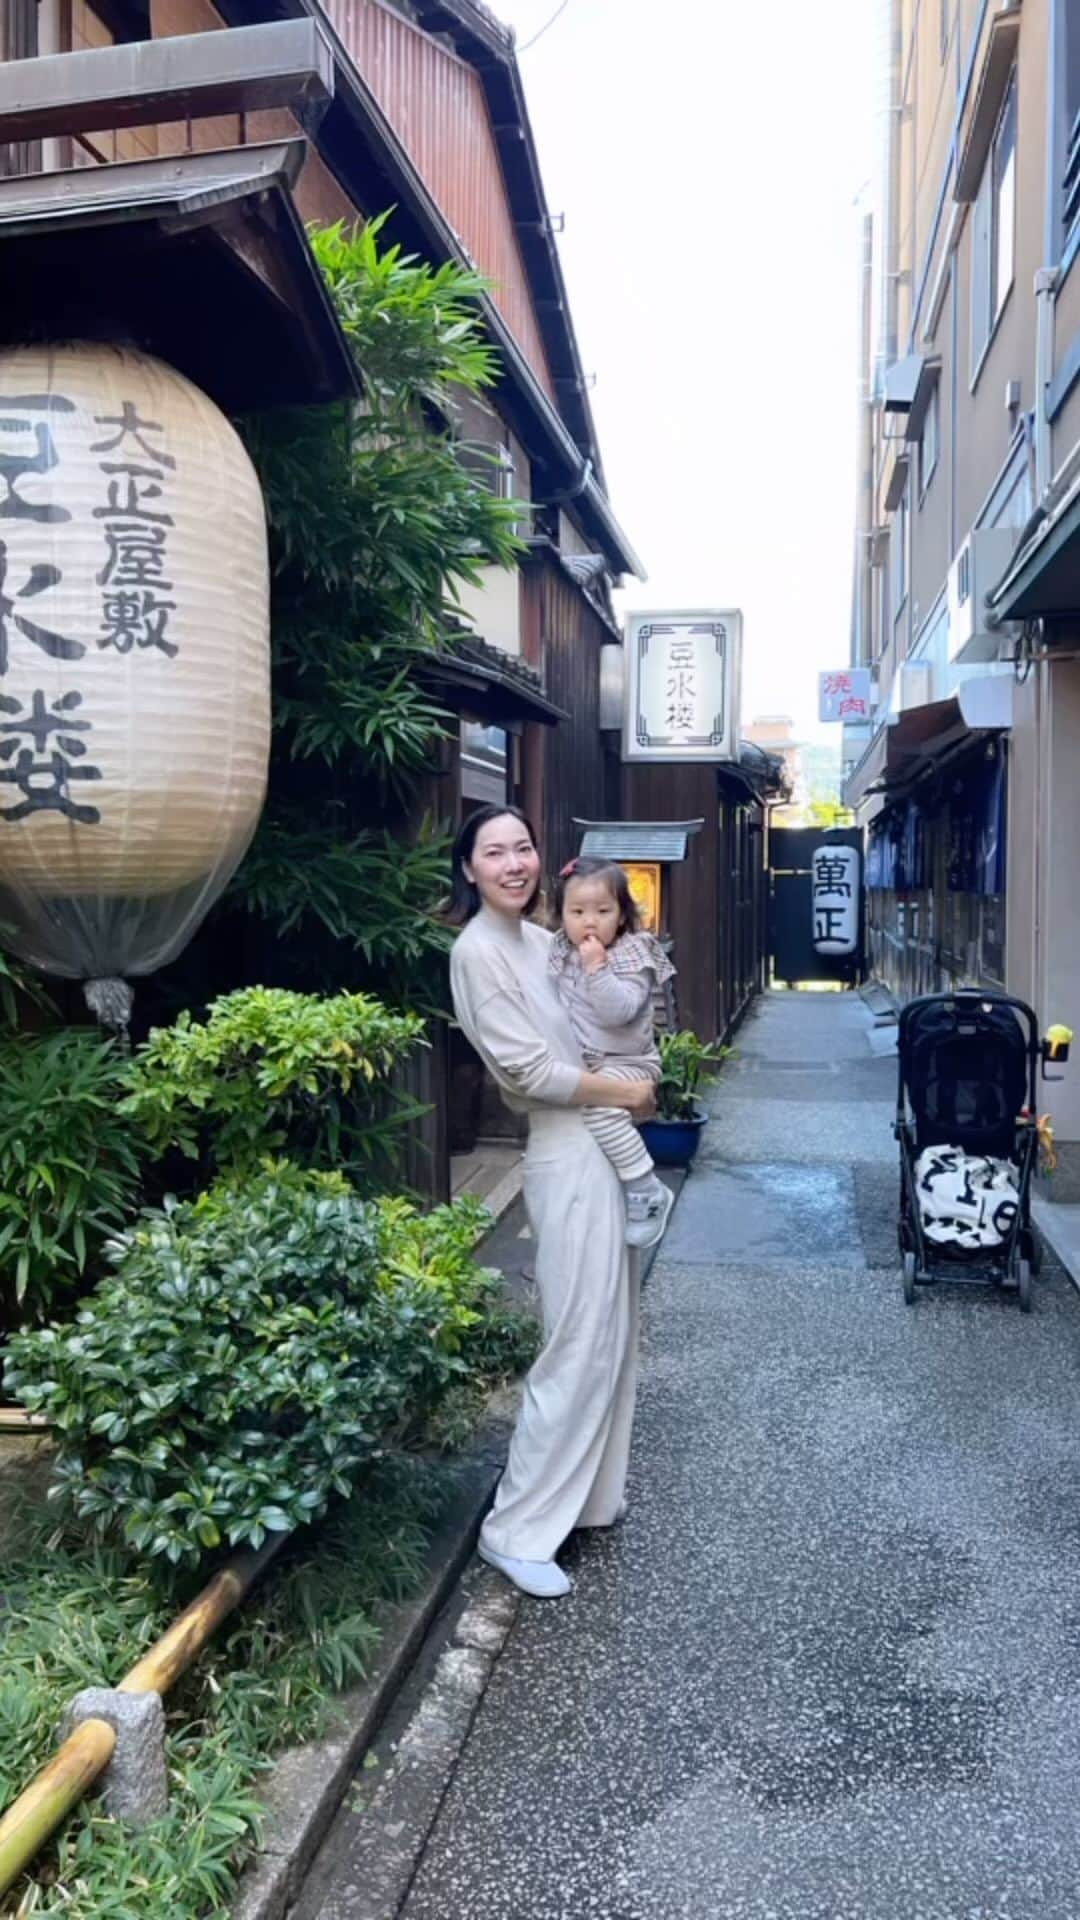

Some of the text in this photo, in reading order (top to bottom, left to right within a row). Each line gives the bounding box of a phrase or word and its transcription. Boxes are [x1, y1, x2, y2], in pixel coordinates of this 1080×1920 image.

[90, 401, 179, 658] 大正屋敷
[666, 641, 697, 730] 豆水楼
[823, 673, 865, 715] 焼肉
[814, 855, 851, 944] 萬正
